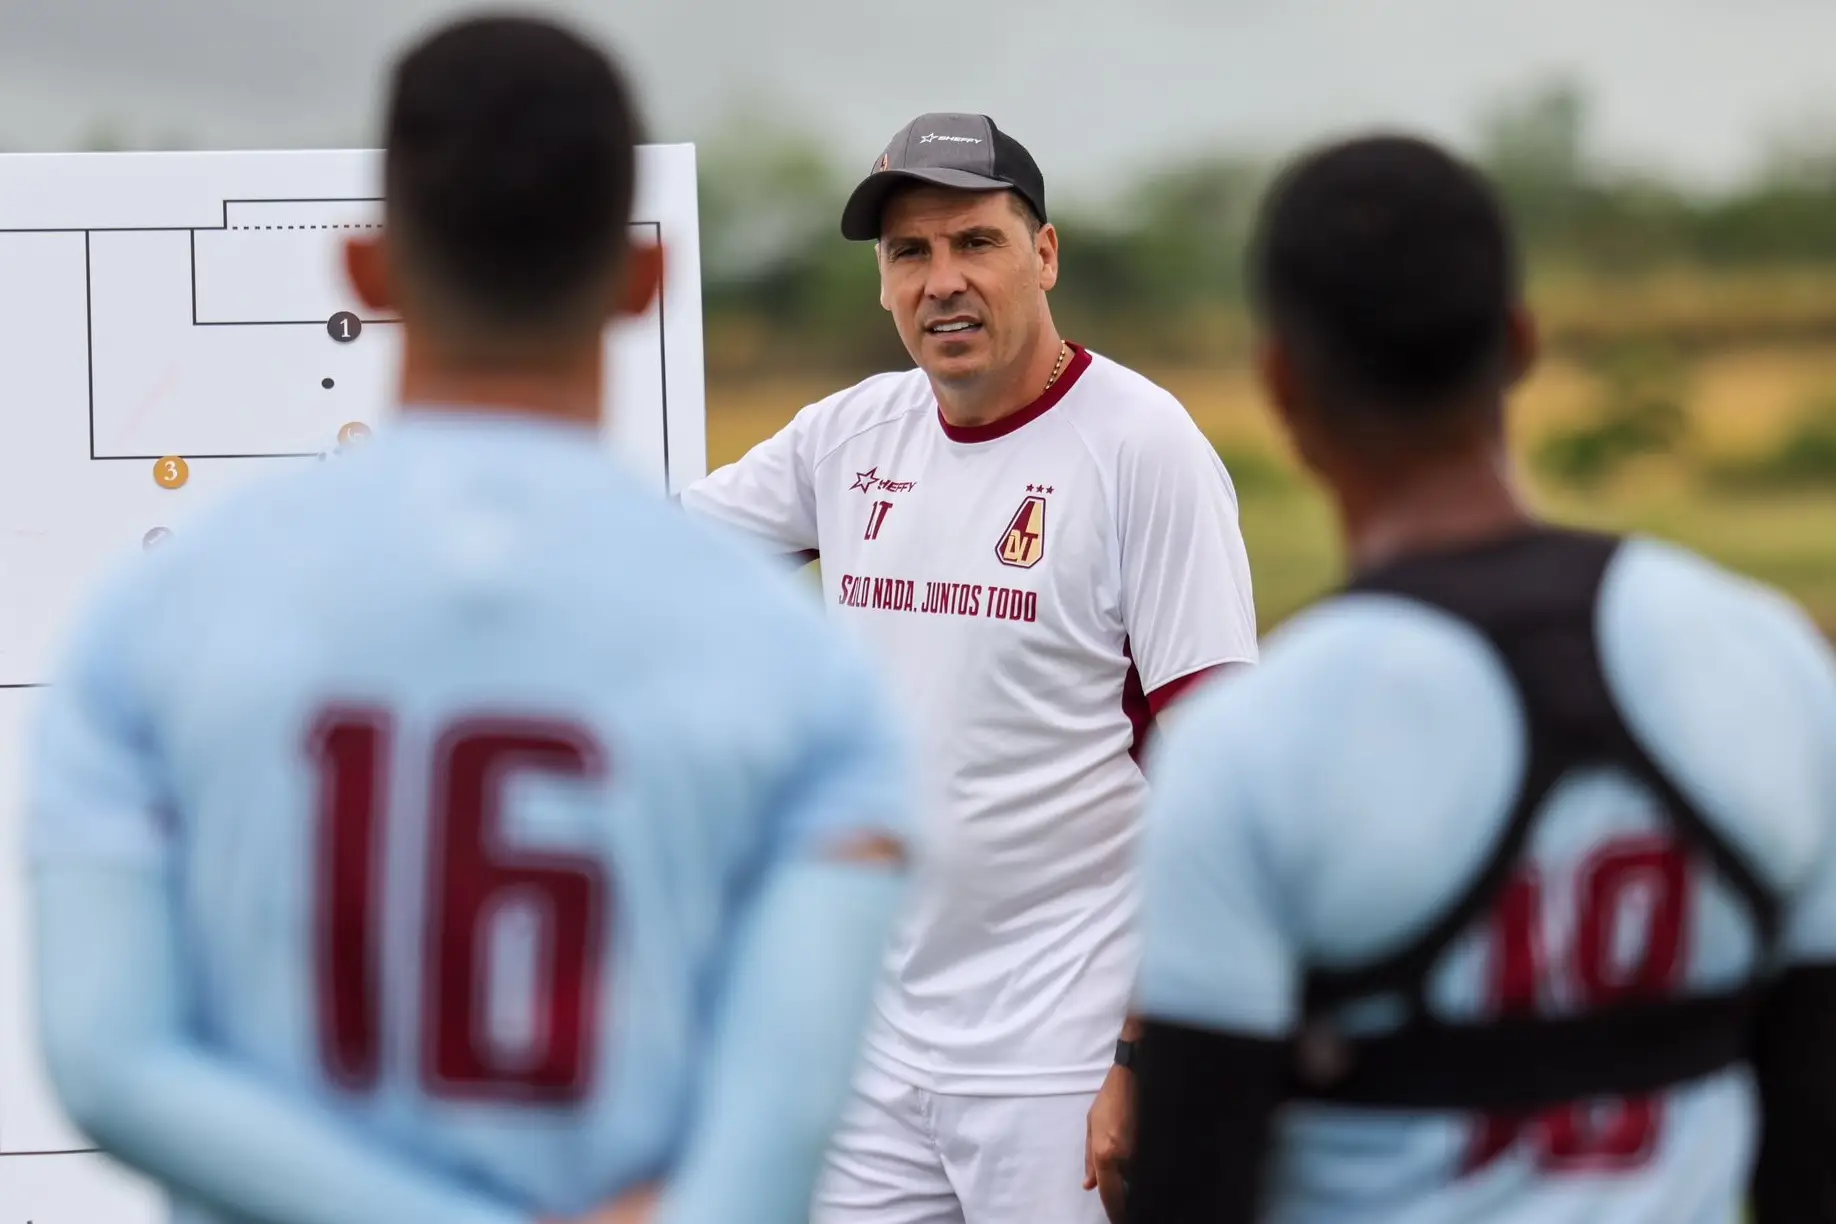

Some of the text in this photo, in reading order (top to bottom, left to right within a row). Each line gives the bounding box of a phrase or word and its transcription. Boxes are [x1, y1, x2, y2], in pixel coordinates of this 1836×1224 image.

[938, 135, 982, 144] SHEFFY
[340, 318, 351, 338] 1
[163, 460, 178, 481] 3
[872, 577, 917, 613] NADA.
[921, 581, 982, 616] JUNTOS
[986, 586, 1038, 622] TODO
[306, 703, 610, 1107] 16
